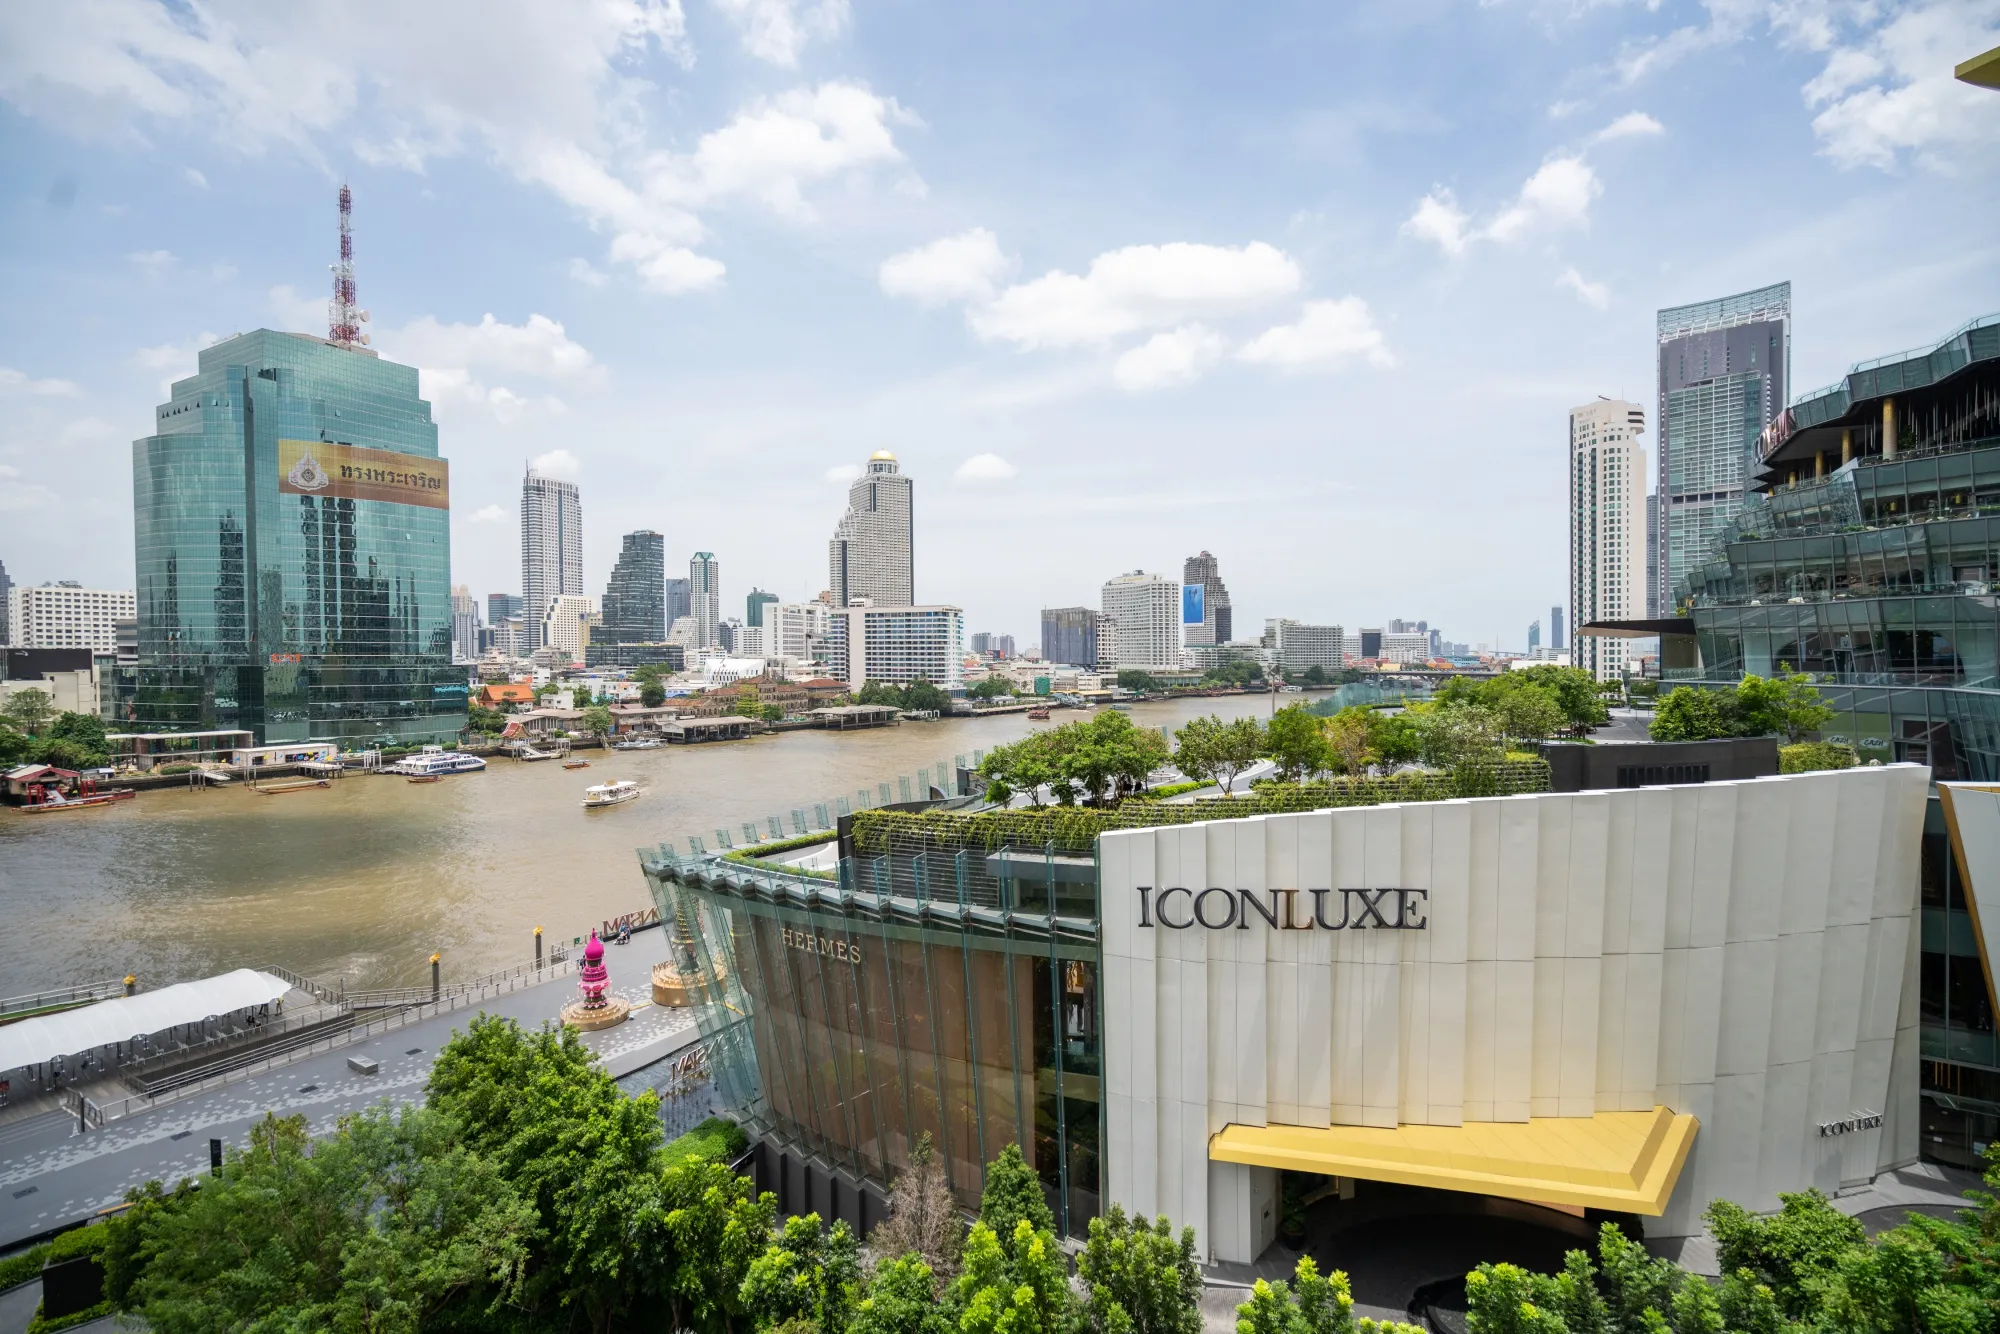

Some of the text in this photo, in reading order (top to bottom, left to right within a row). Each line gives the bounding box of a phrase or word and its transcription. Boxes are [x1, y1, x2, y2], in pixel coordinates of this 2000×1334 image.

[340, 464, 441, 490] ทรงพระเจริญ
[1136, 886, 1428, 930] ICONLUXE
